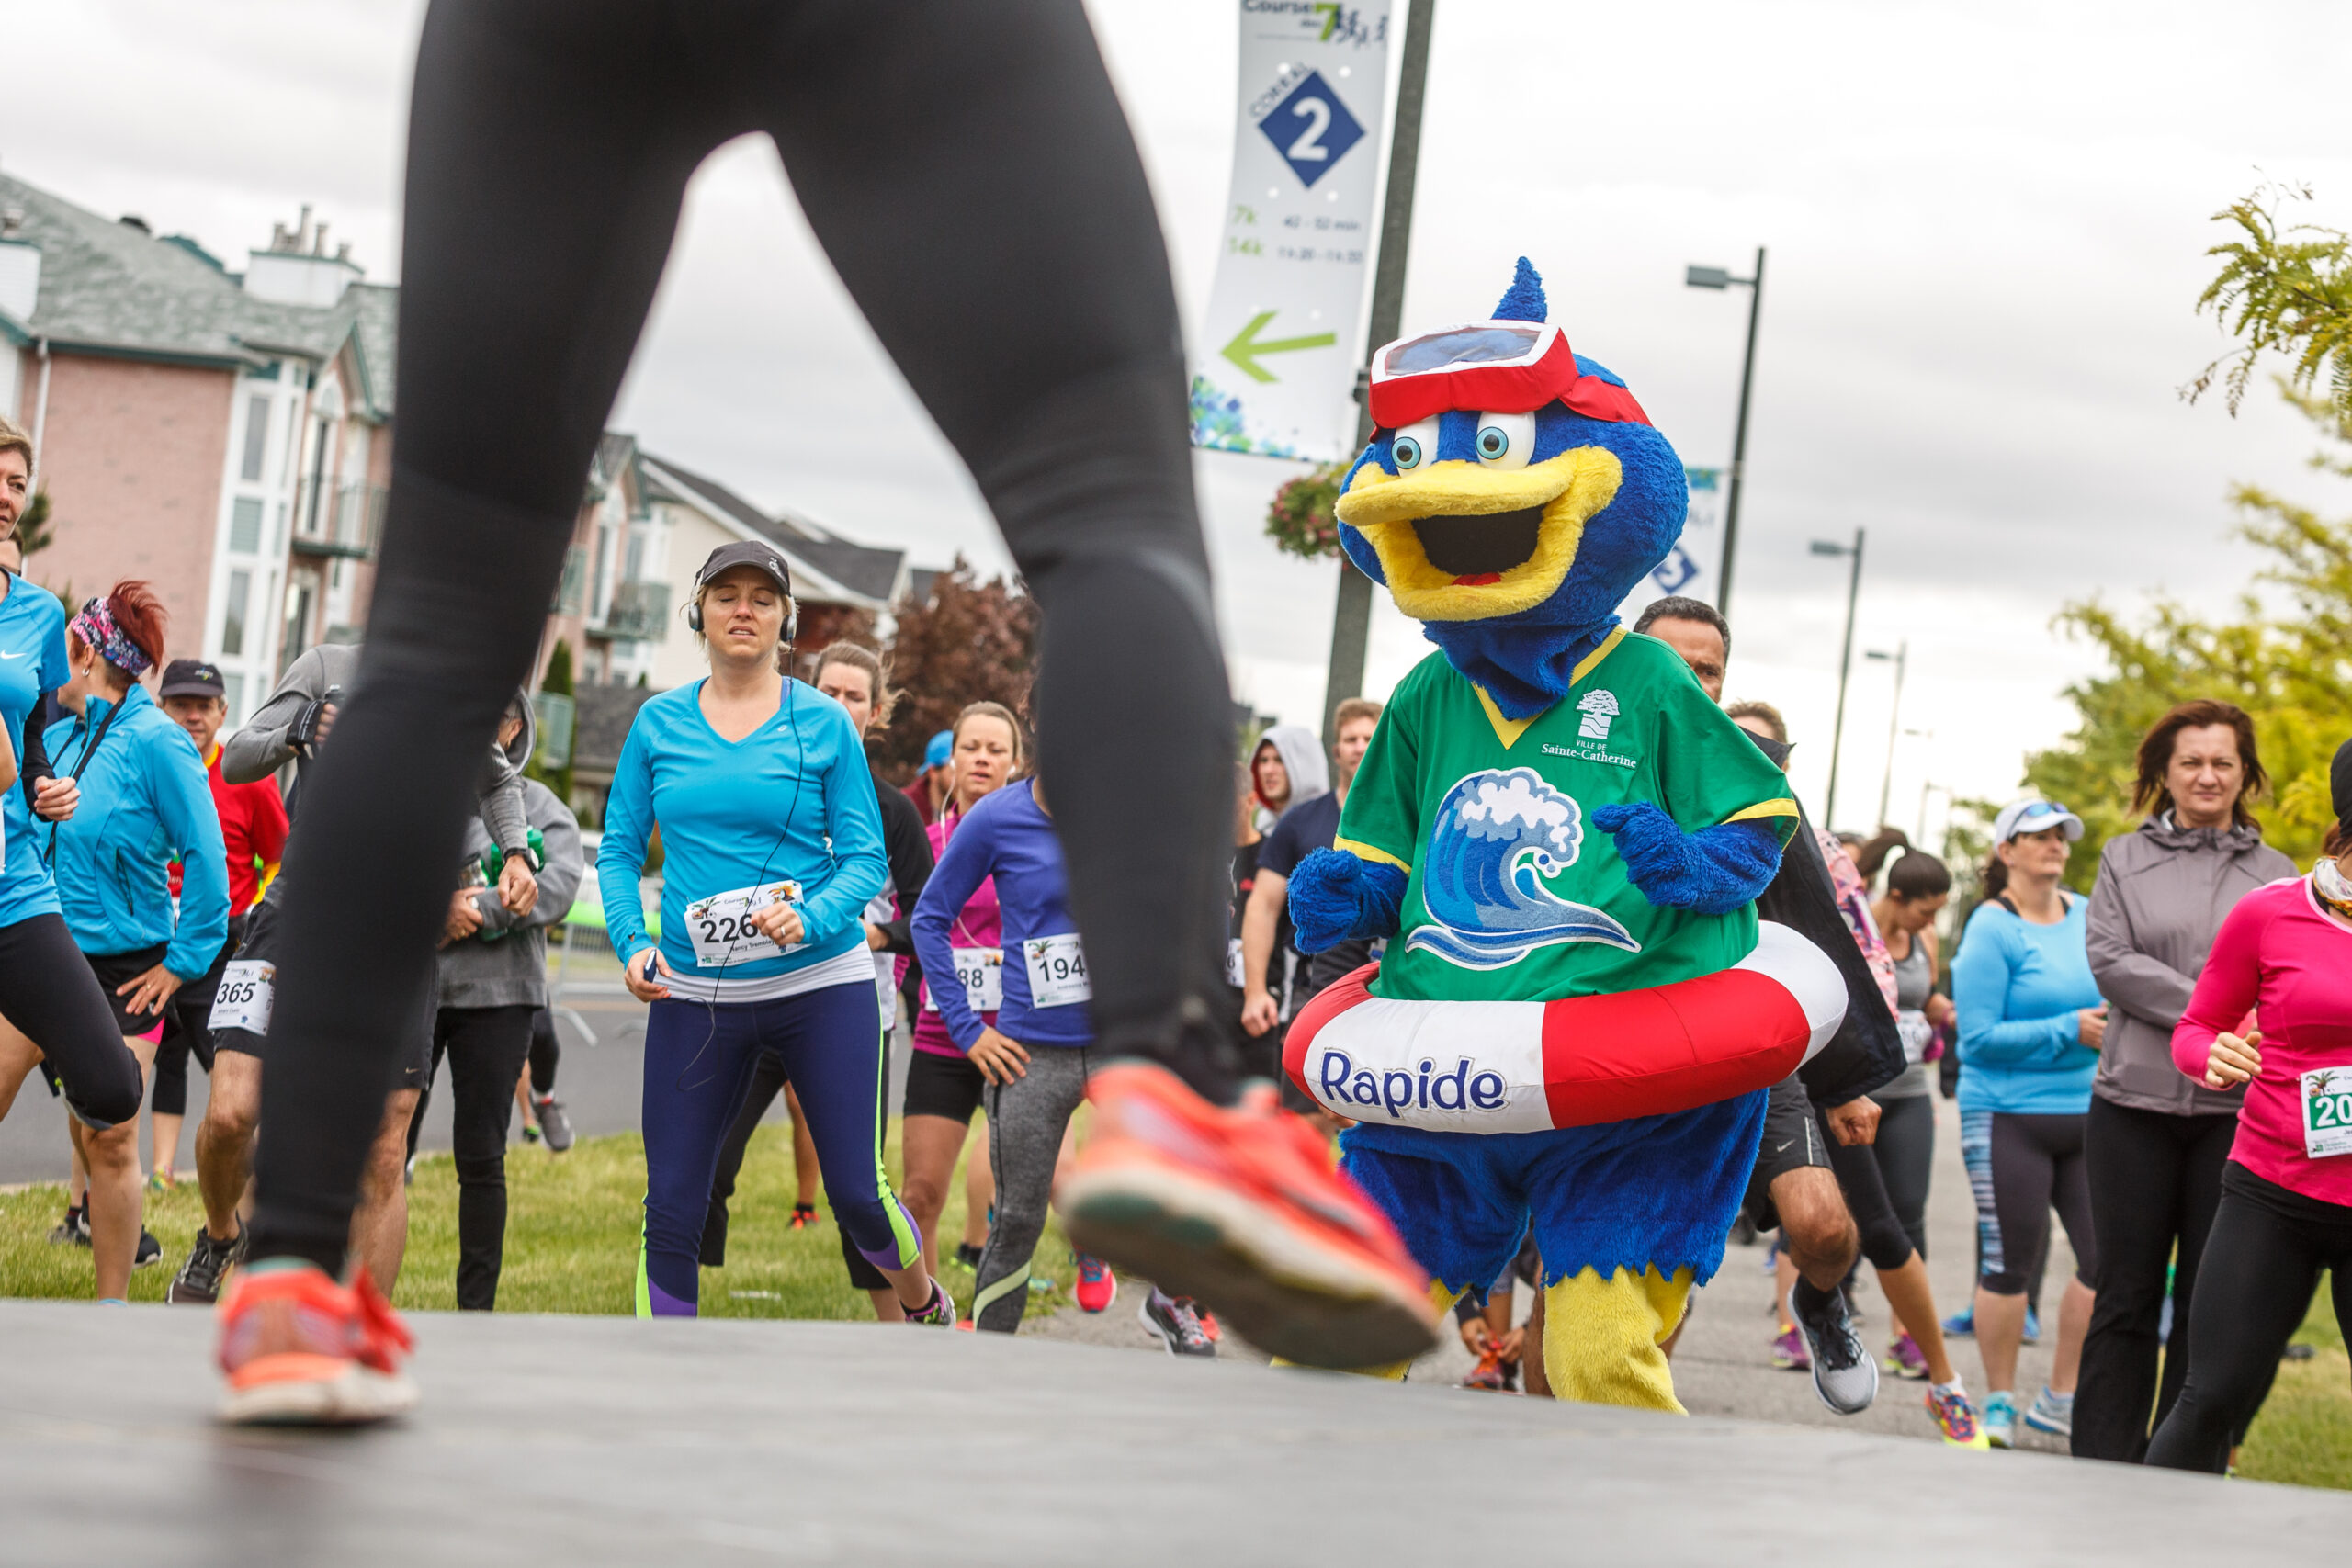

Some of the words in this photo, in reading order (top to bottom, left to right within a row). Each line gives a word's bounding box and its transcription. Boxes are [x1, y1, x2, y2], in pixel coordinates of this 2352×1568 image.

[1286, 96, 1332, 162] 2
[1541, 742, 1637, 769] Sainte-Catherine
[1576, 739, 1596, 750] VILLE
[1597, 743, 1608, 751] DE
[1038, 953, 1086, 983] 194
[216, 982, 256, 1005] 365
[1320, 1051, 1506, 1119] Rapide
[2314, 1093, 2352, 1129] 20
